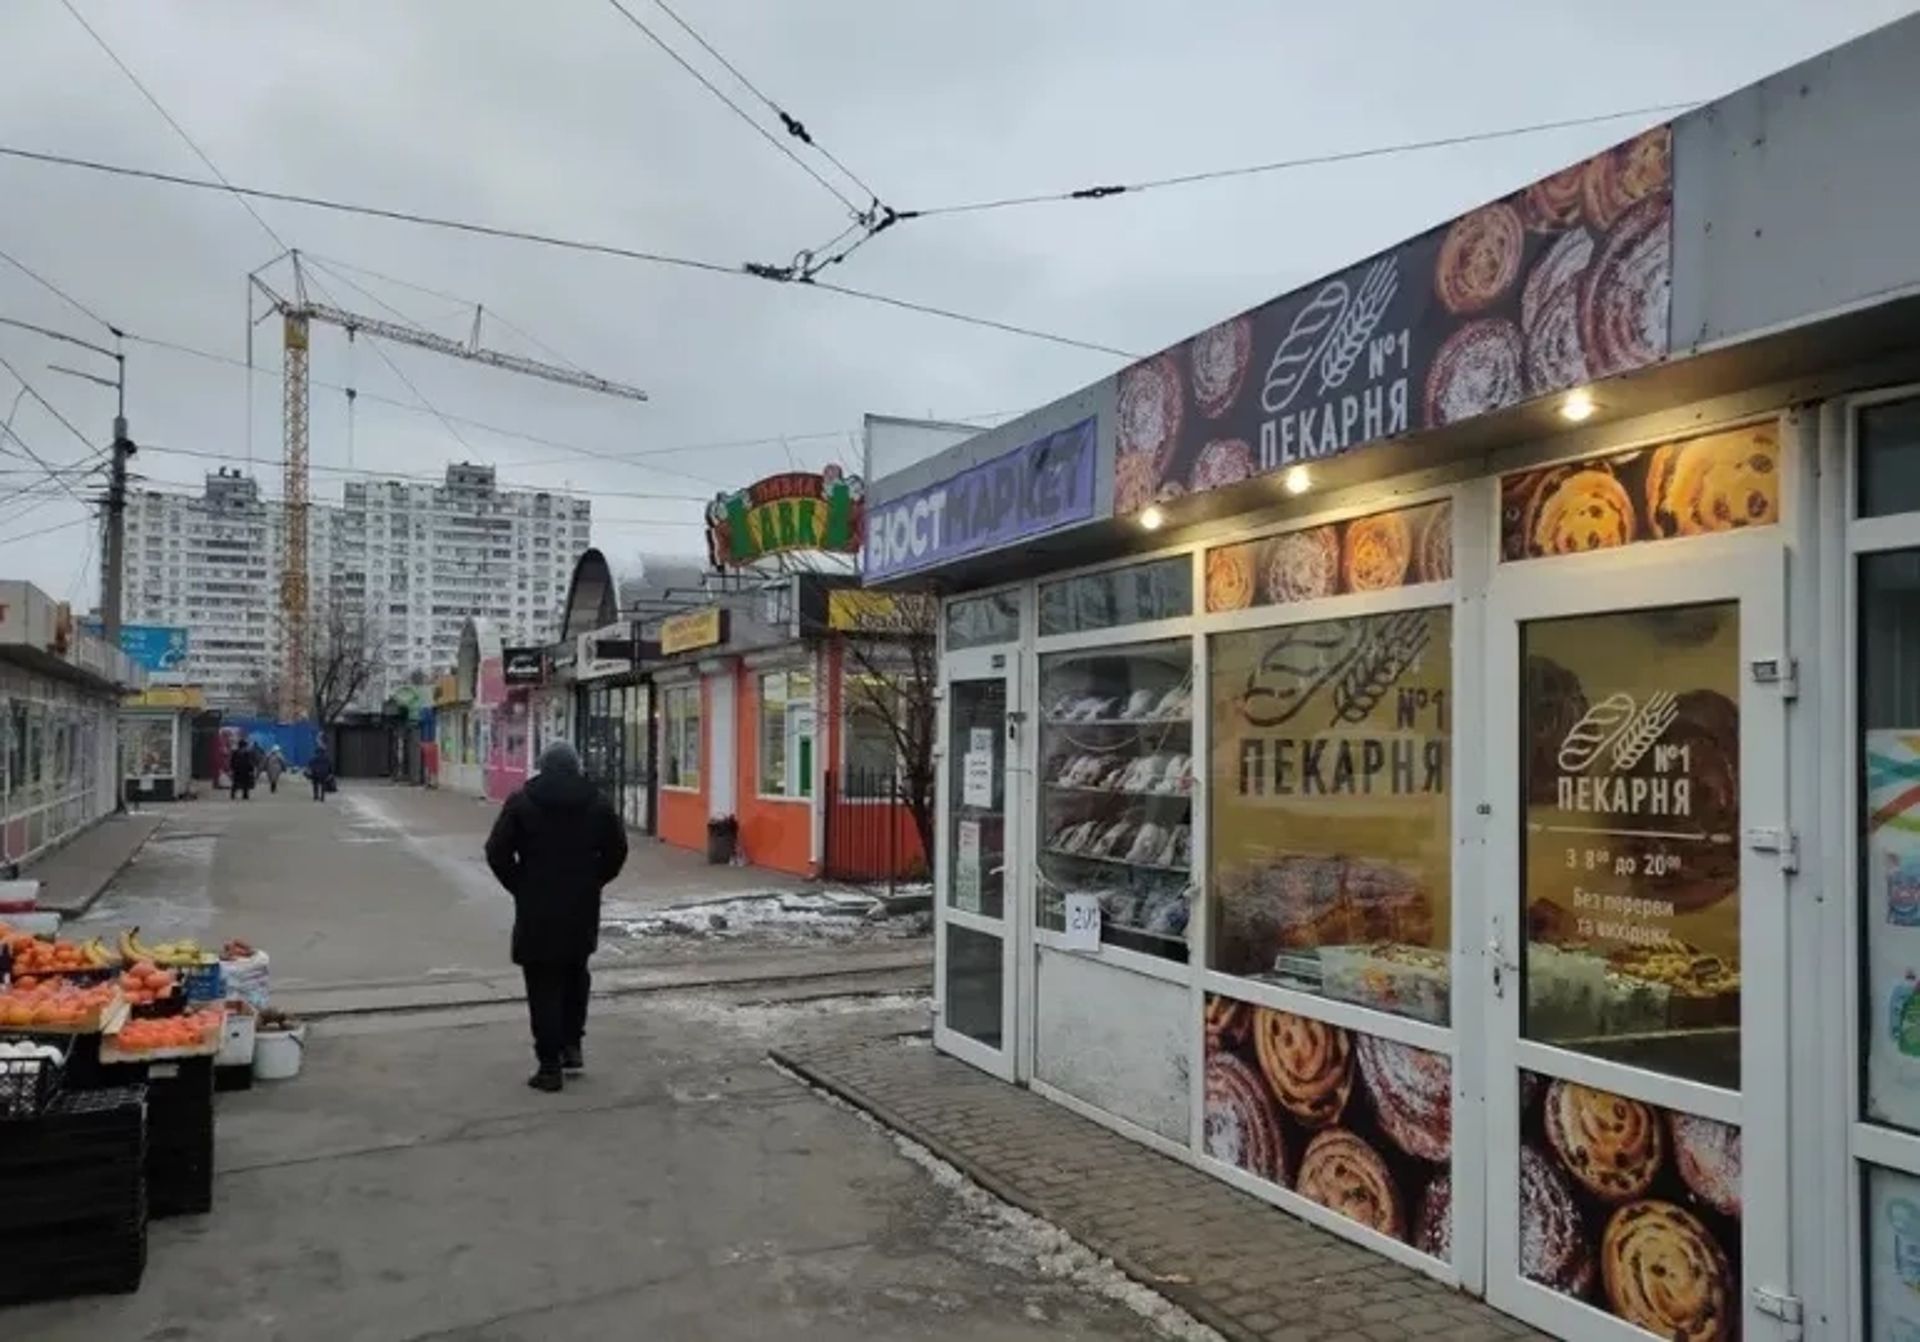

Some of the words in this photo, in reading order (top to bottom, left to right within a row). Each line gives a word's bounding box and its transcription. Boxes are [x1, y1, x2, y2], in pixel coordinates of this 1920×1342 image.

[1368, 329, 1410, 379] №1
[1260, 378, 1408, 470] ПЕКАРНЯ
[1239, 738, 1444, 796] ПЕКАРНЯ
[1654, 744, 1690, 773] №1
[1558, 776, 1690, 816] ПЕКАРНЯ
[1615, 856, 1637, 877] до
[1573, 886, 1600, 909] Без
